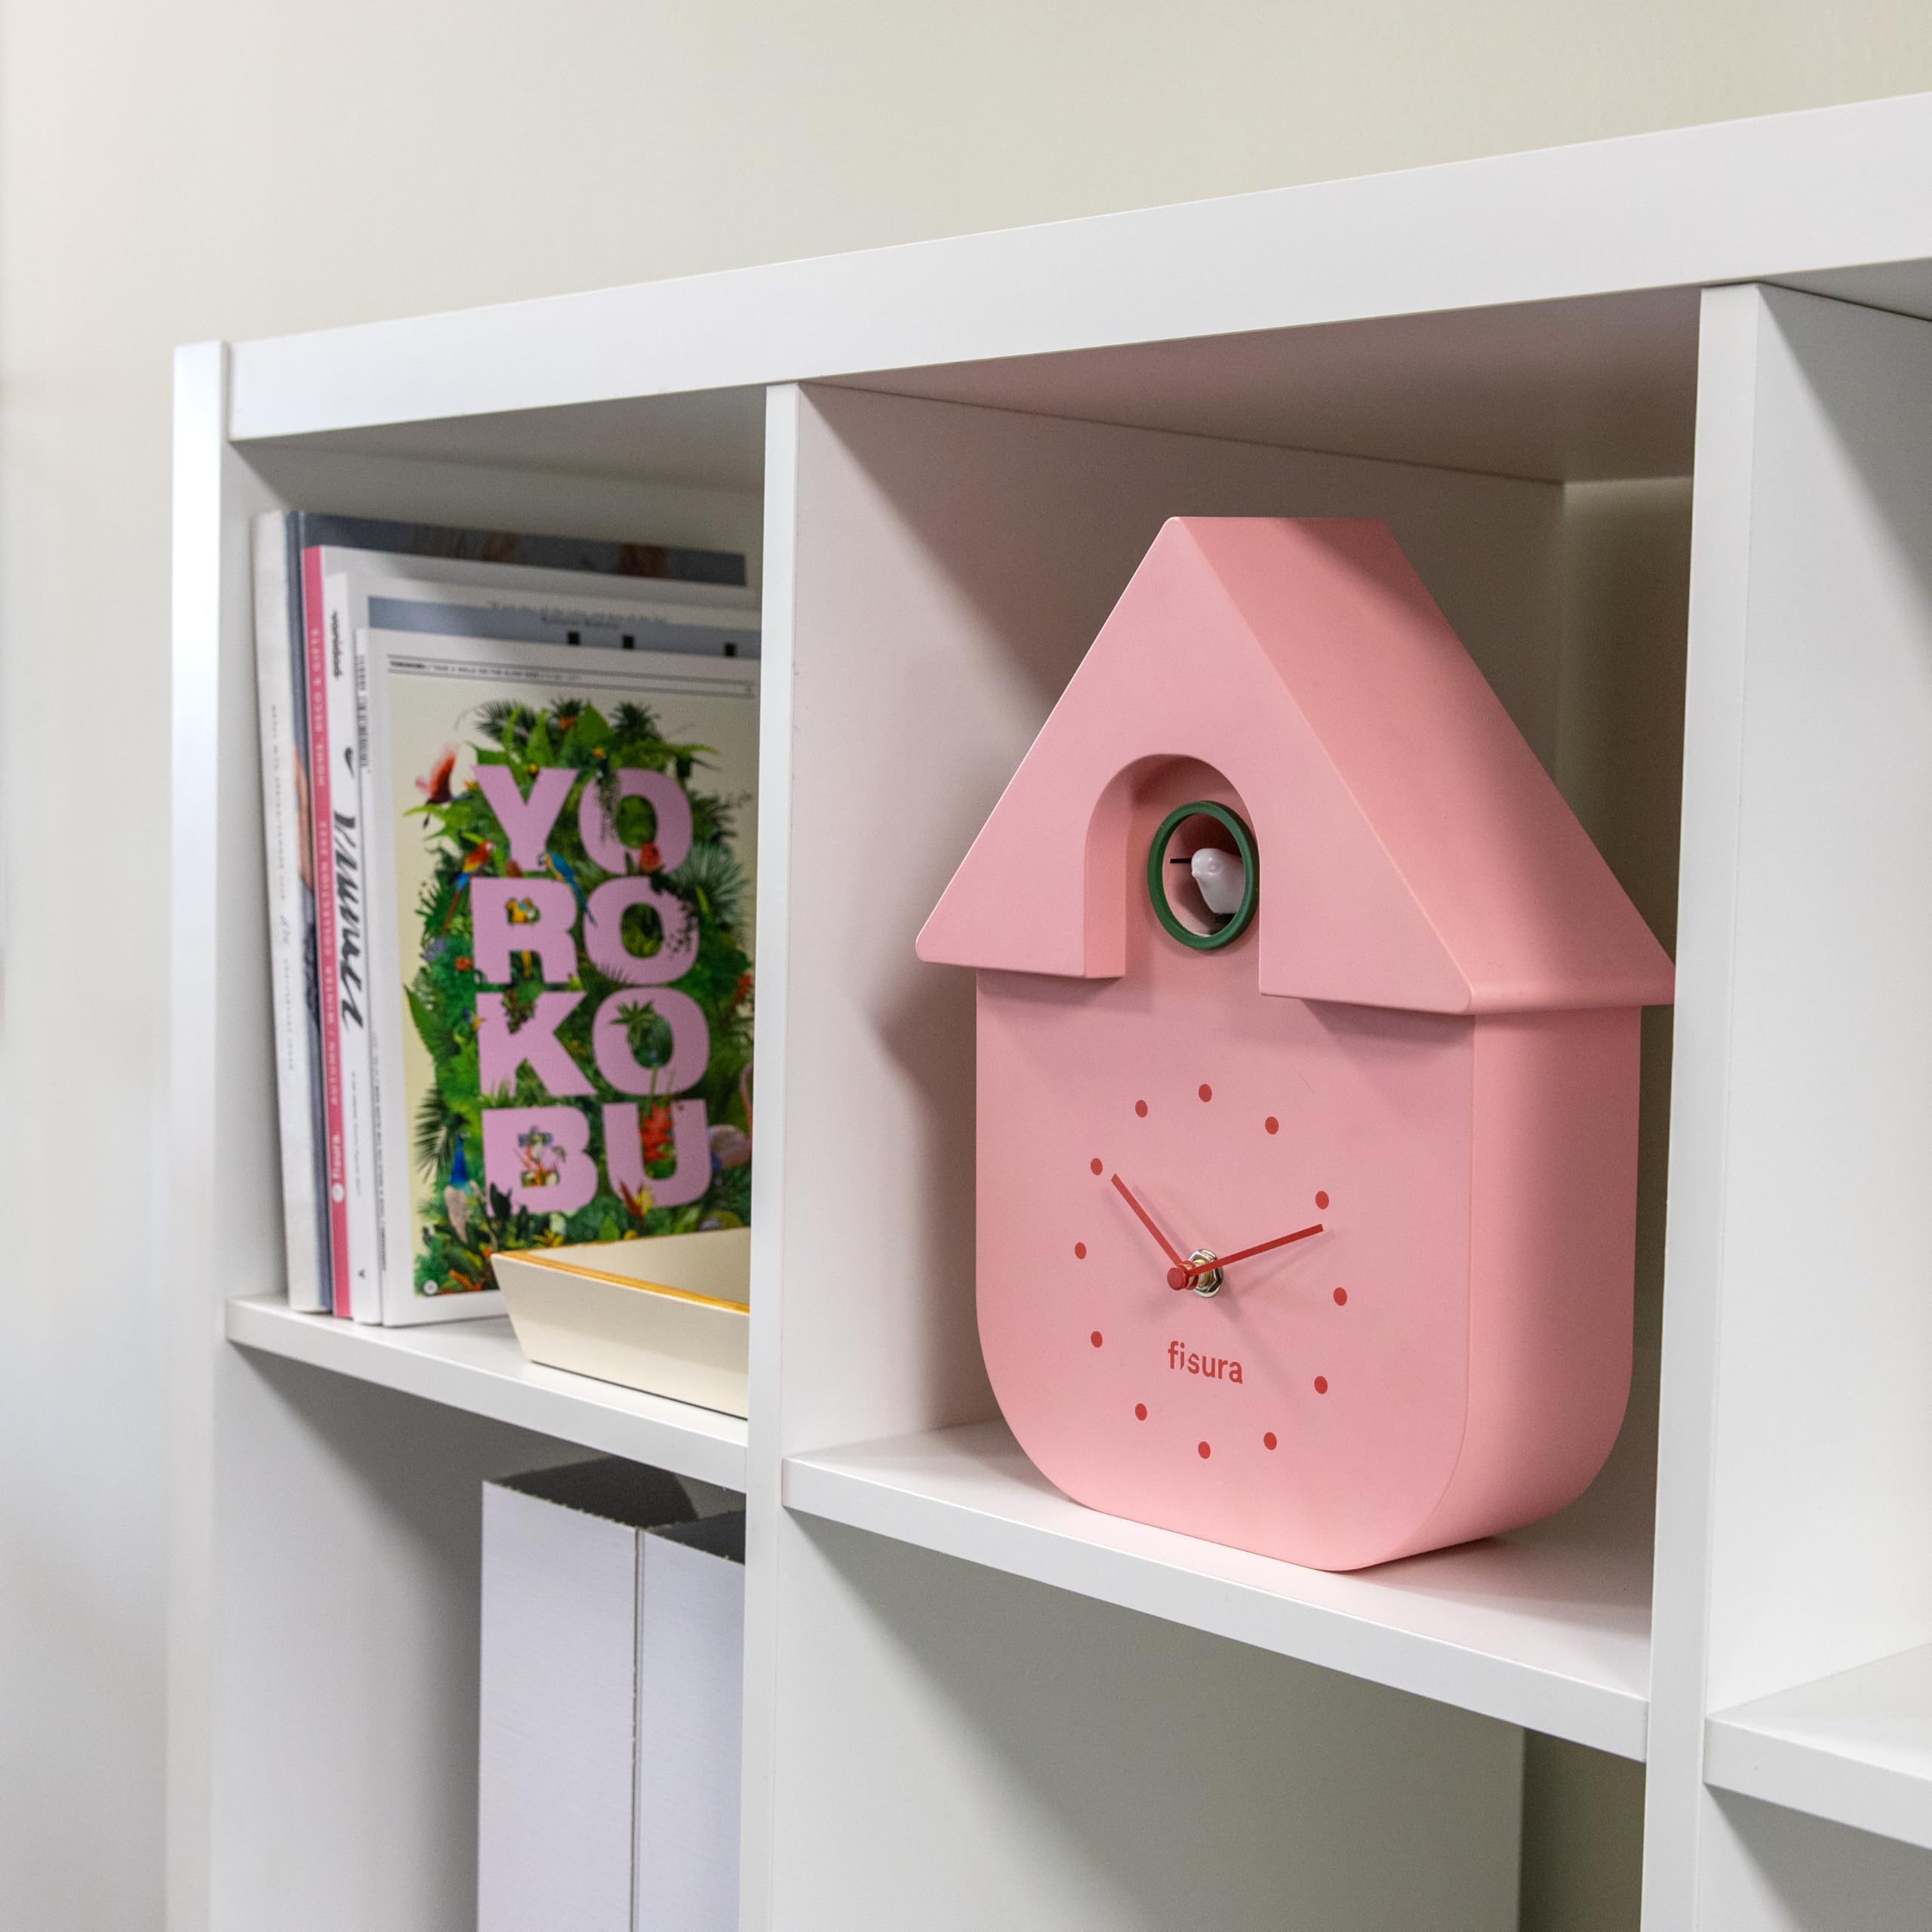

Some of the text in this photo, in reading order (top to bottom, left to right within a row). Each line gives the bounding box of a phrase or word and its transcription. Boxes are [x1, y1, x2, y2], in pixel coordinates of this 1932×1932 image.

[472, 764, 694, 875] YO
[470, 875, 700, 986] RO
[475, 986, 710, 1097] KO
[481, 1099, 712, 1217] BU
[1168, 1340, 1243, 1384] fisura
